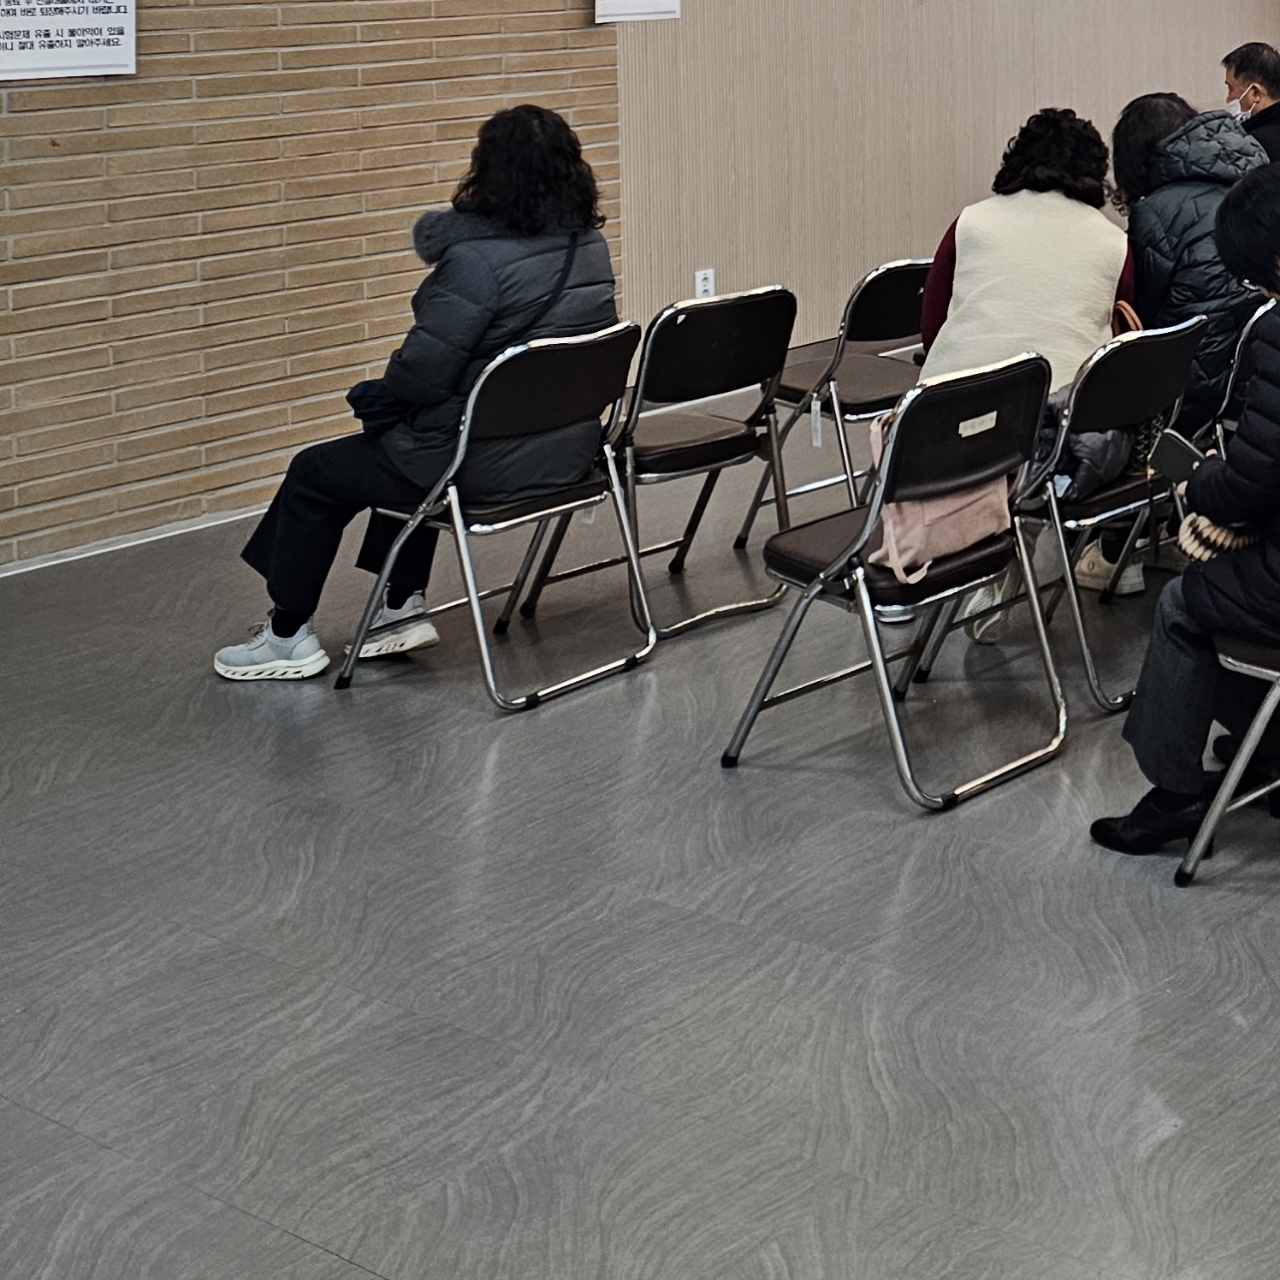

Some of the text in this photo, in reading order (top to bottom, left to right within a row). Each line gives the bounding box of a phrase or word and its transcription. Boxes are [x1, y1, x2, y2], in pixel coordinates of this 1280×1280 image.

[20, 7, 37, 17] 바로
[40, 6, 89, 17] 퇴장해주시기
[34, 29, 51, 39] 유출
[54, 28, 64, 38] 시
[68, 27, 103, 38] 불이익이
[106, 26, 125, 36] 있을
[18, 41, 34, 50] 절대
[38, 40, 72, 50] 유출하지
